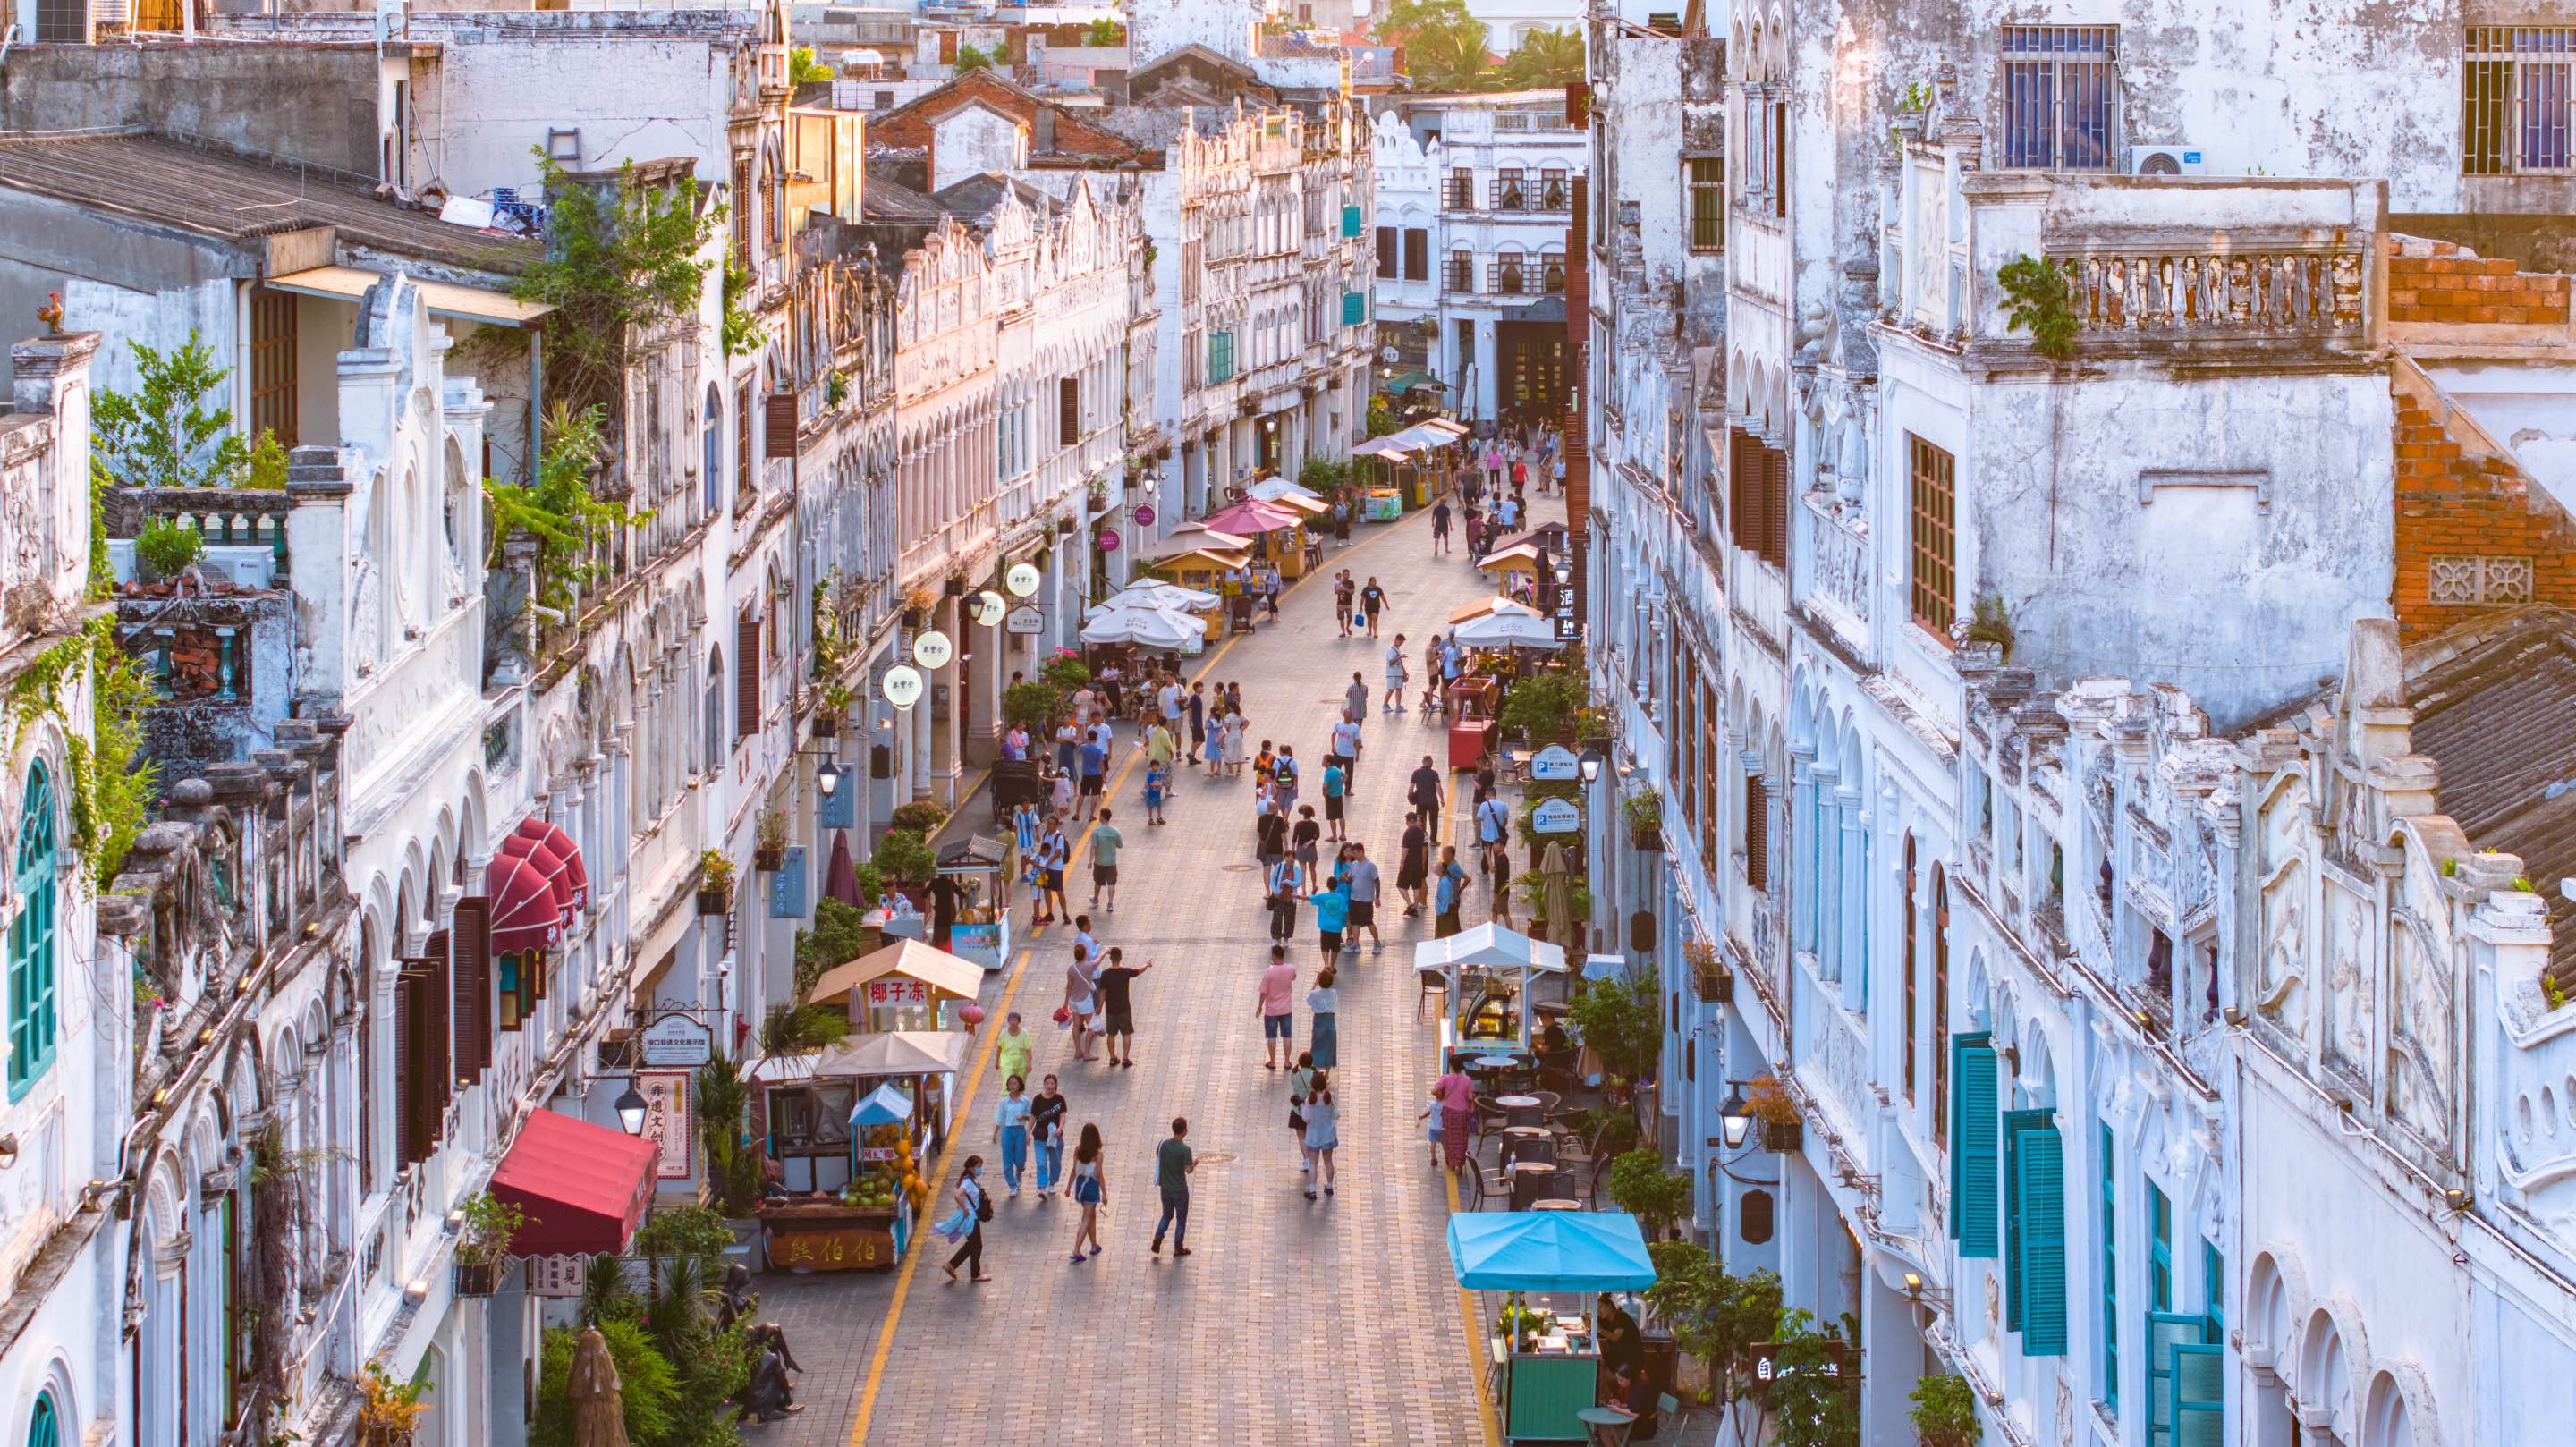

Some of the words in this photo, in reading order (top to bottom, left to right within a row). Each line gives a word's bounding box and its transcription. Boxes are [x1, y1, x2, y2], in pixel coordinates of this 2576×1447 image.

[1560, 589, 1573, 605] 酒
[870, 982, 925, 1003] 椰子冻
[789, 1237, 876, 1262] 熊伯伯
